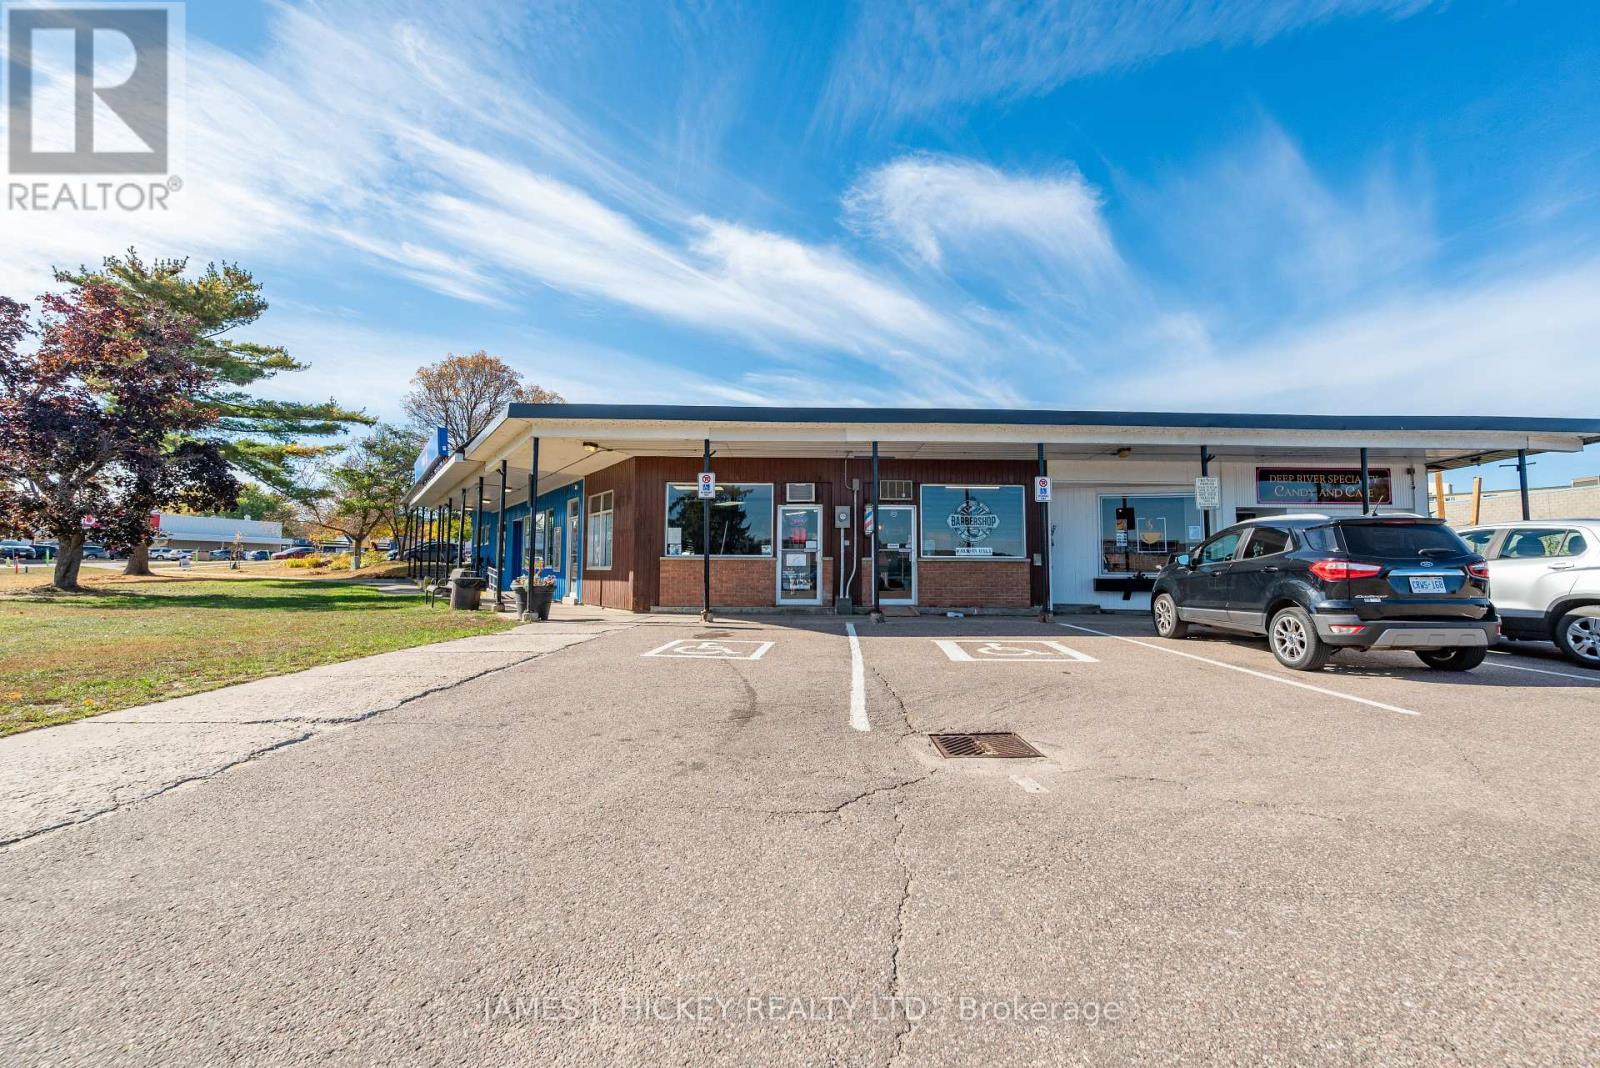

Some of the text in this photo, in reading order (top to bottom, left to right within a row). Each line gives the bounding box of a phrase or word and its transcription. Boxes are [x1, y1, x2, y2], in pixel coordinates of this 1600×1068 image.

[1269, 474, 1379, 485] DEEP RIVER SPECIATY
[1274, 485, 1374, 498] CANDY AND CAE
[951, 515, 996, 527] BARBERSHOP
